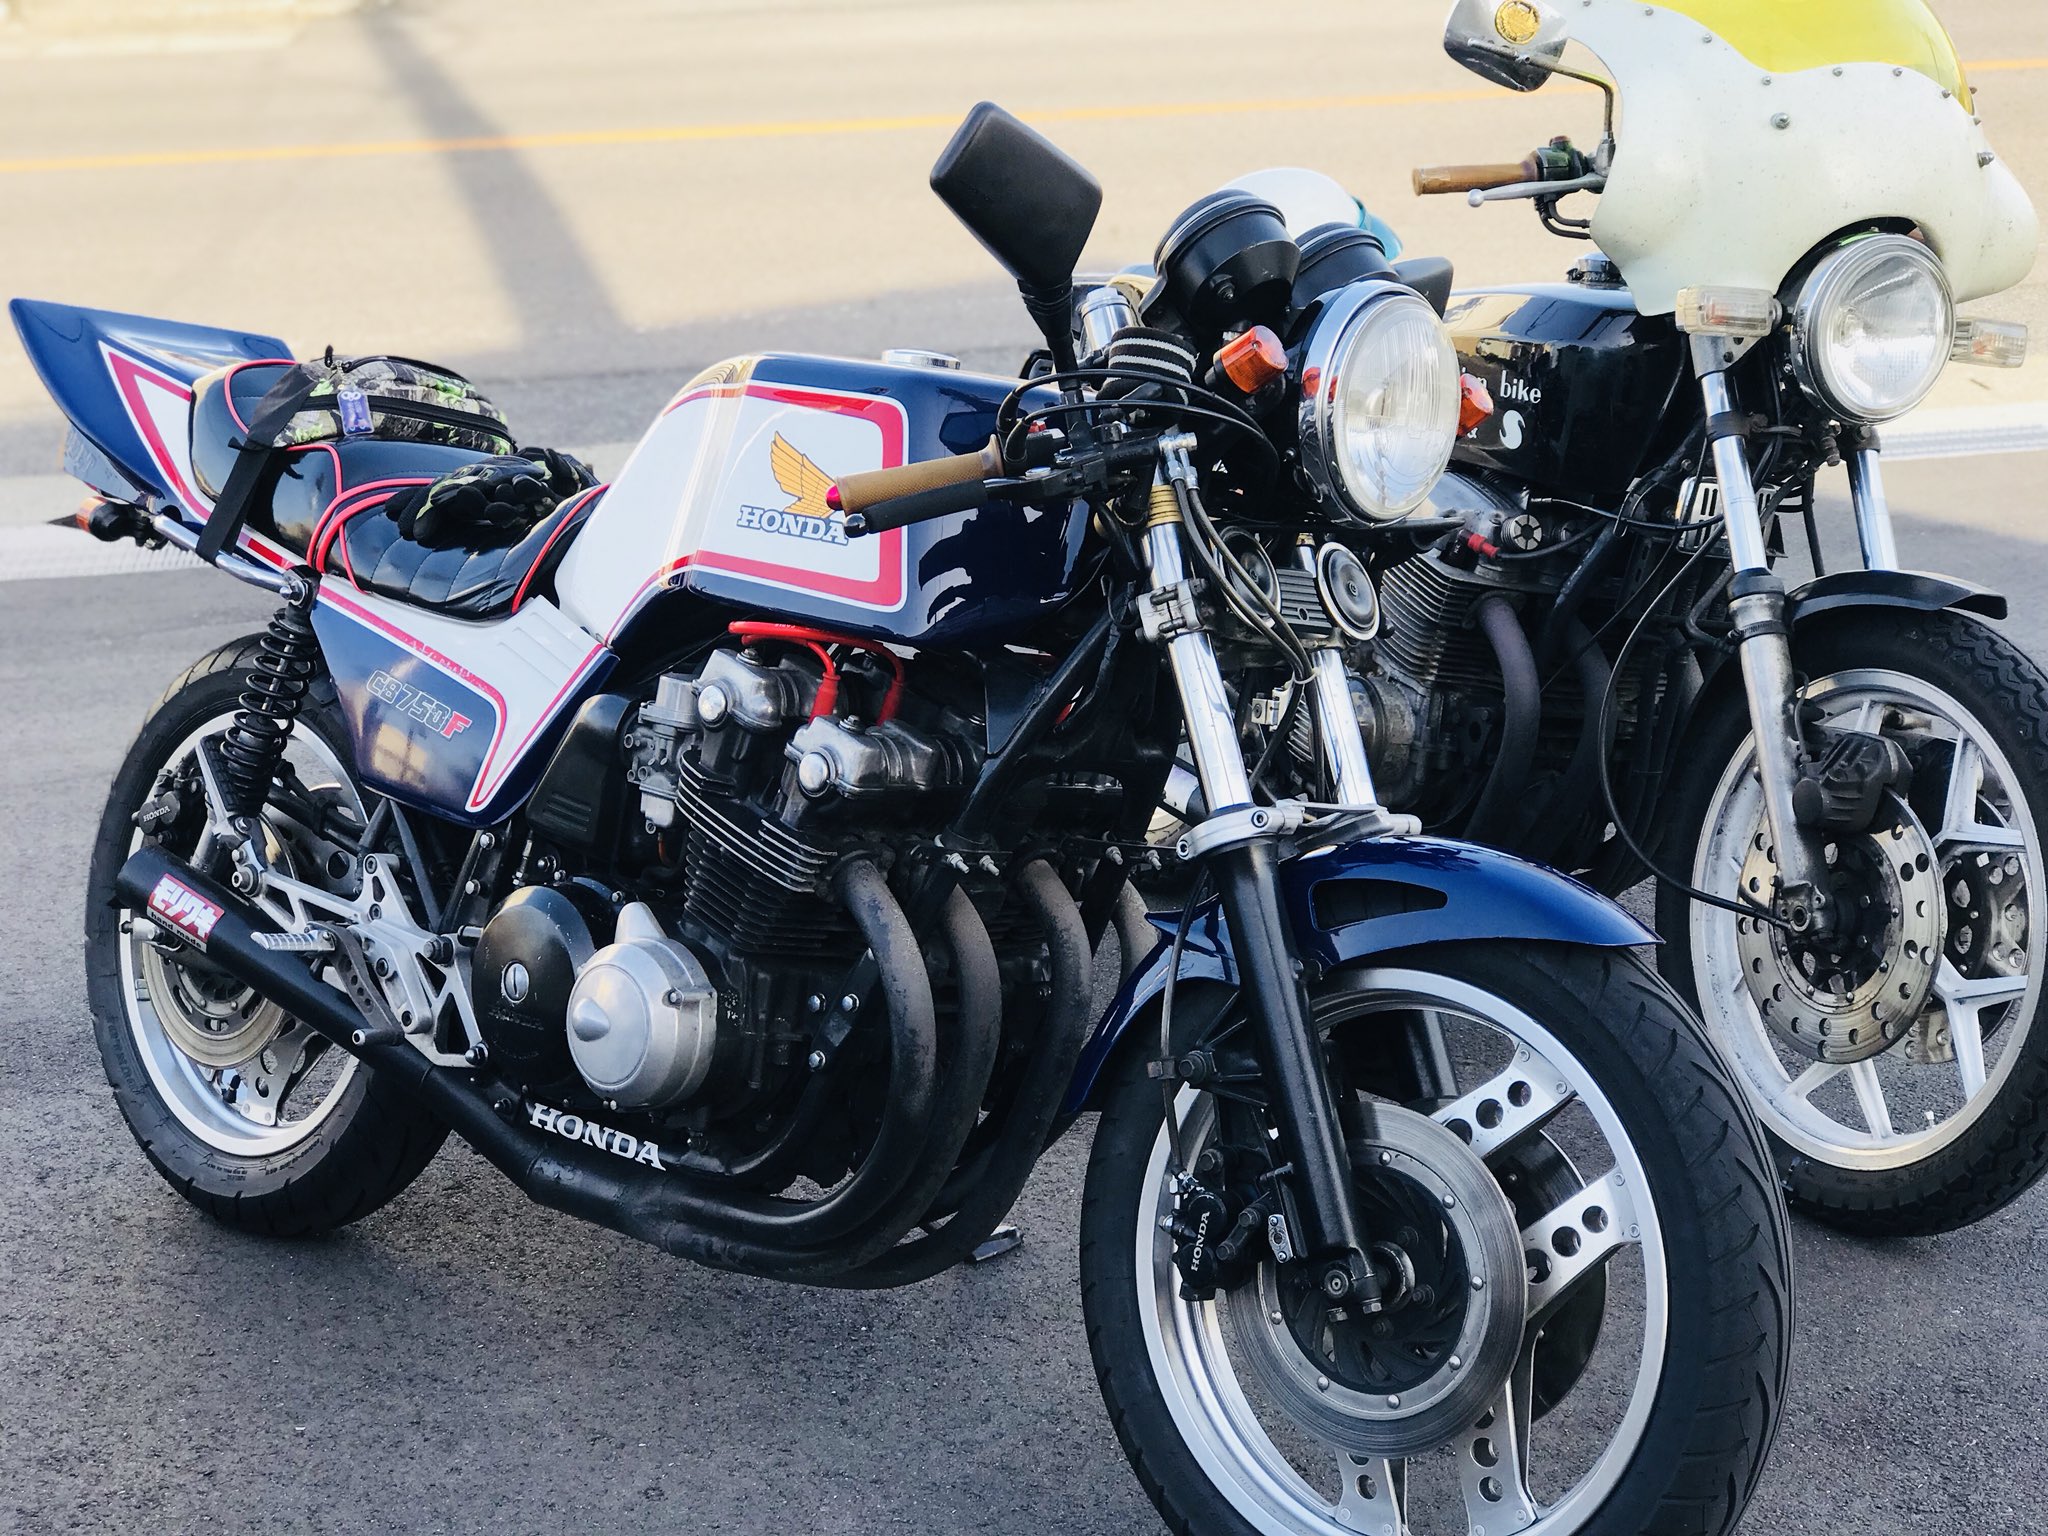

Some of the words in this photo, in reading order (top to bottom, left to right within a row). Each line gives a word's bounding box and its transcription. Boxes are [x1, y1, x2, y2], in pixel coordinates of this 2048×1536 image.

[1500, 369, 1542, 404] bike
[737, 504, 849, 546] HONDA
[366, 670, 472, 740] CB750F
[143, 805, 171, 823] HONDA
[151, 912, 174, 930] hand
[176, 929, 202, 949] made
[152, 876, 218, 939] モリワキ
[529, 1102, 667, 1172] HONDA
[1190, 1211, 1211, 1272] HONDA
